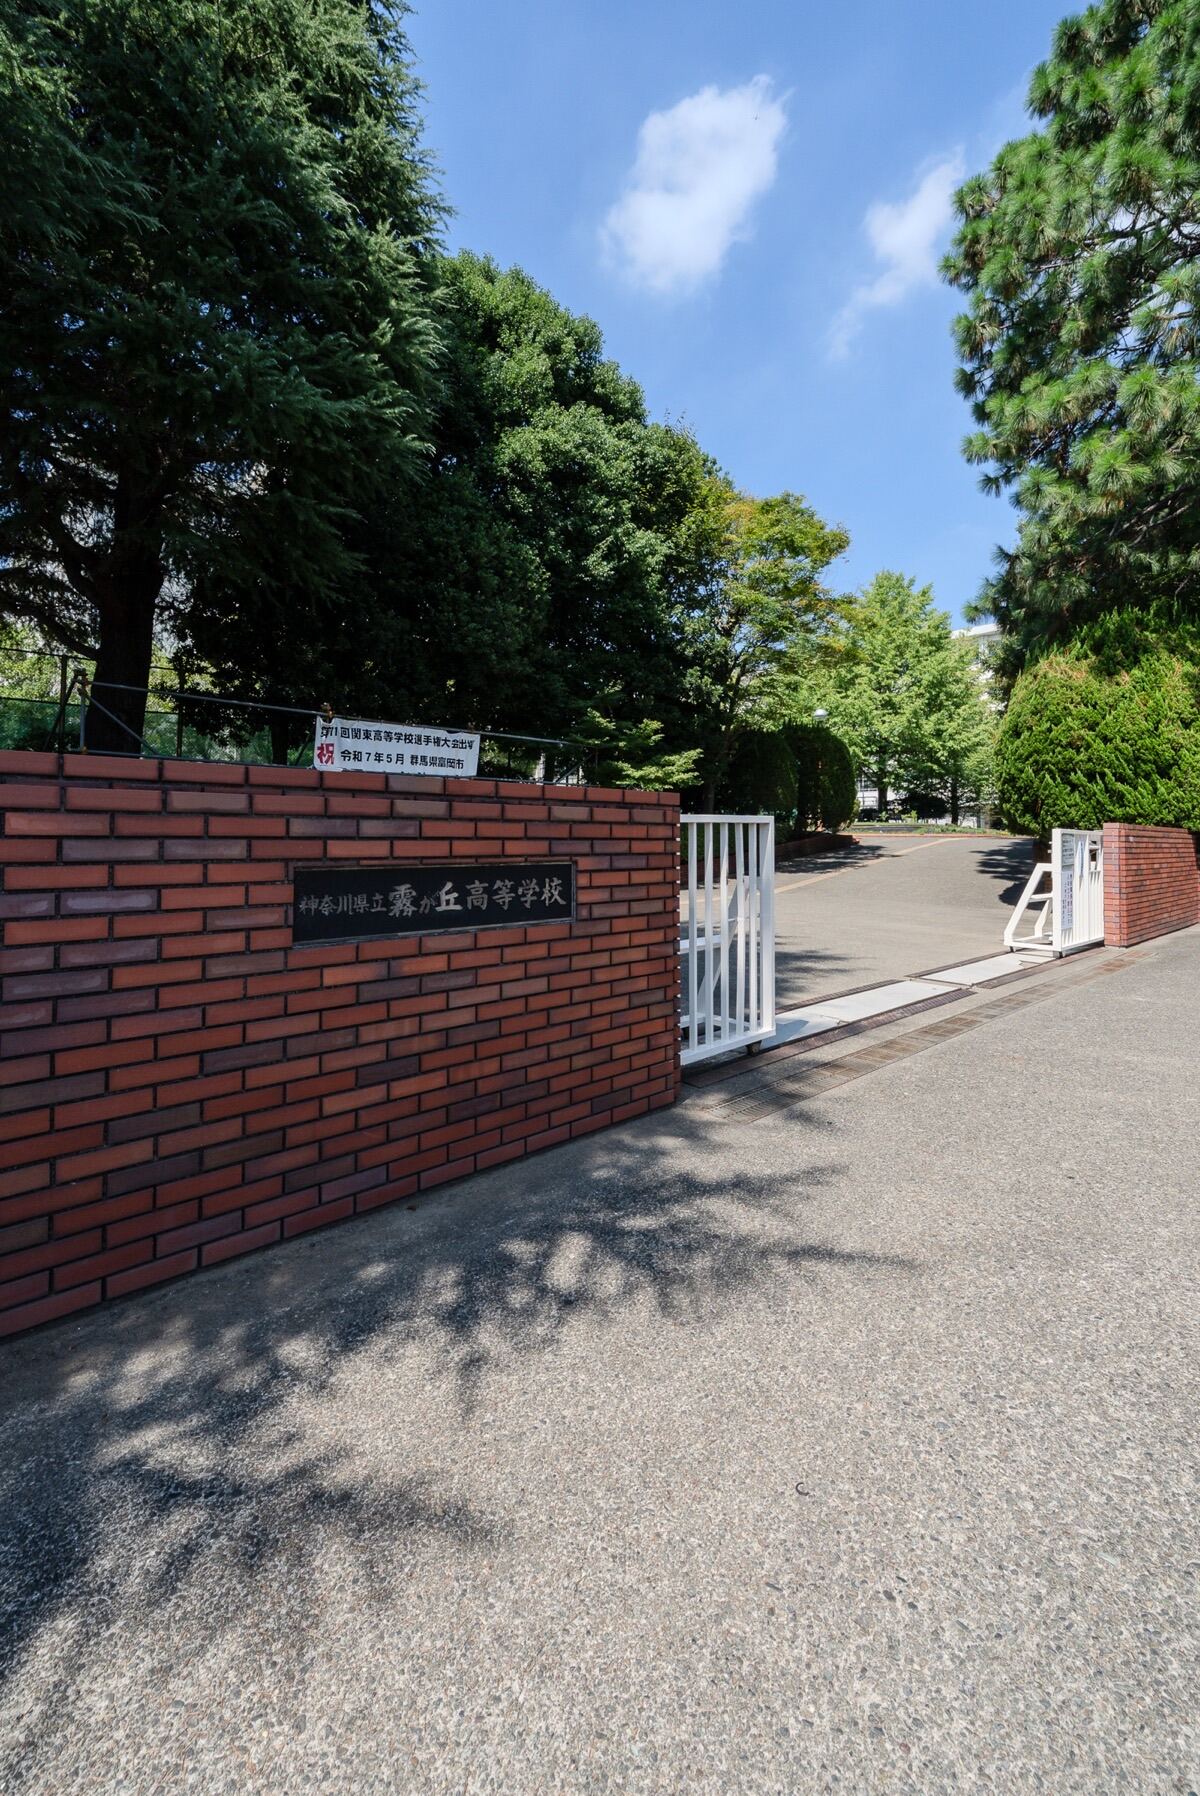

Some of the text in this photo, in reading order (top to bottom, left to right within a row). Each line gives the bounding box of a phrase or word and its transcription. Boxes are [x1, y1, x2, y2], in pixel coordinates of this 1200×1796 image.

[317, 743, 335, 765] 祝
[340, 749, 465, 770] 令和7年5月 群馬県富岡市
[299, 877, 567, 917] 神奈川県立霧が丘高等学校
